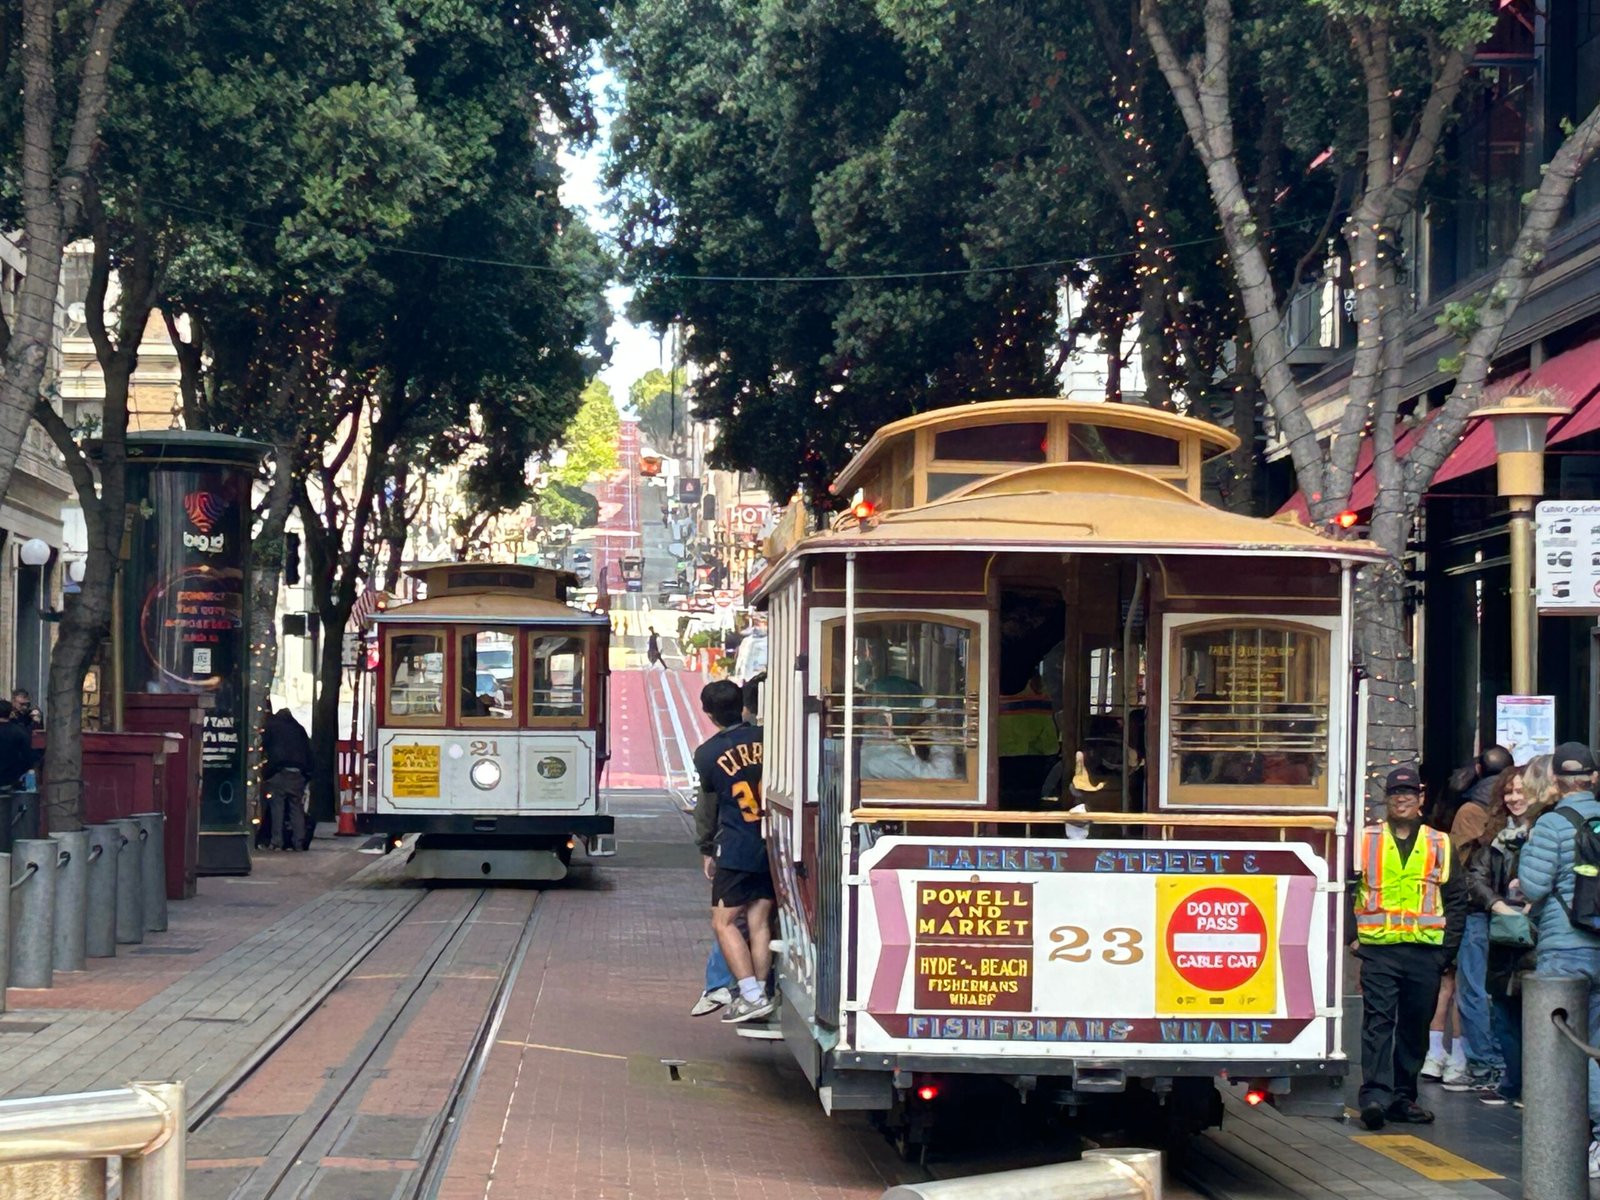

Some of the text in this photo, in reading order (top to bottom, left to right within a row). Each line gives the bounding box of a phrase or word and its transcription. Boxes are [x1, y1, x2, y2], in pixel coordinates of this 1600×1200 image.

[470, 740, 501, 757] 21
[731, 780, 763, 823] 3
[927, 847, 1068, 872] MARKET
[1095, 850, 1230, 874] STREET
[922, 888, 1028, 906] POWELL
[948, 906, 1002, 918] AND
[1187, 902, 1249, 916] DO NOT
[919, 918, 1029, 936] MARKET
[1196, 917, 1239, 931] PASS
[1048, 925, 1144, 966] 23
[920, 956, 958, 975] HYDE
[980, 958, 1028, 977] BEACH
[1176, 954, 1257, 969] CABLE CAR
[928, 979, 1019, 993] FISHERMANS
[949, 993, 997, 1006] WHARF
[907, 1016, 1273, 1043] FISHERMANS WHARF
